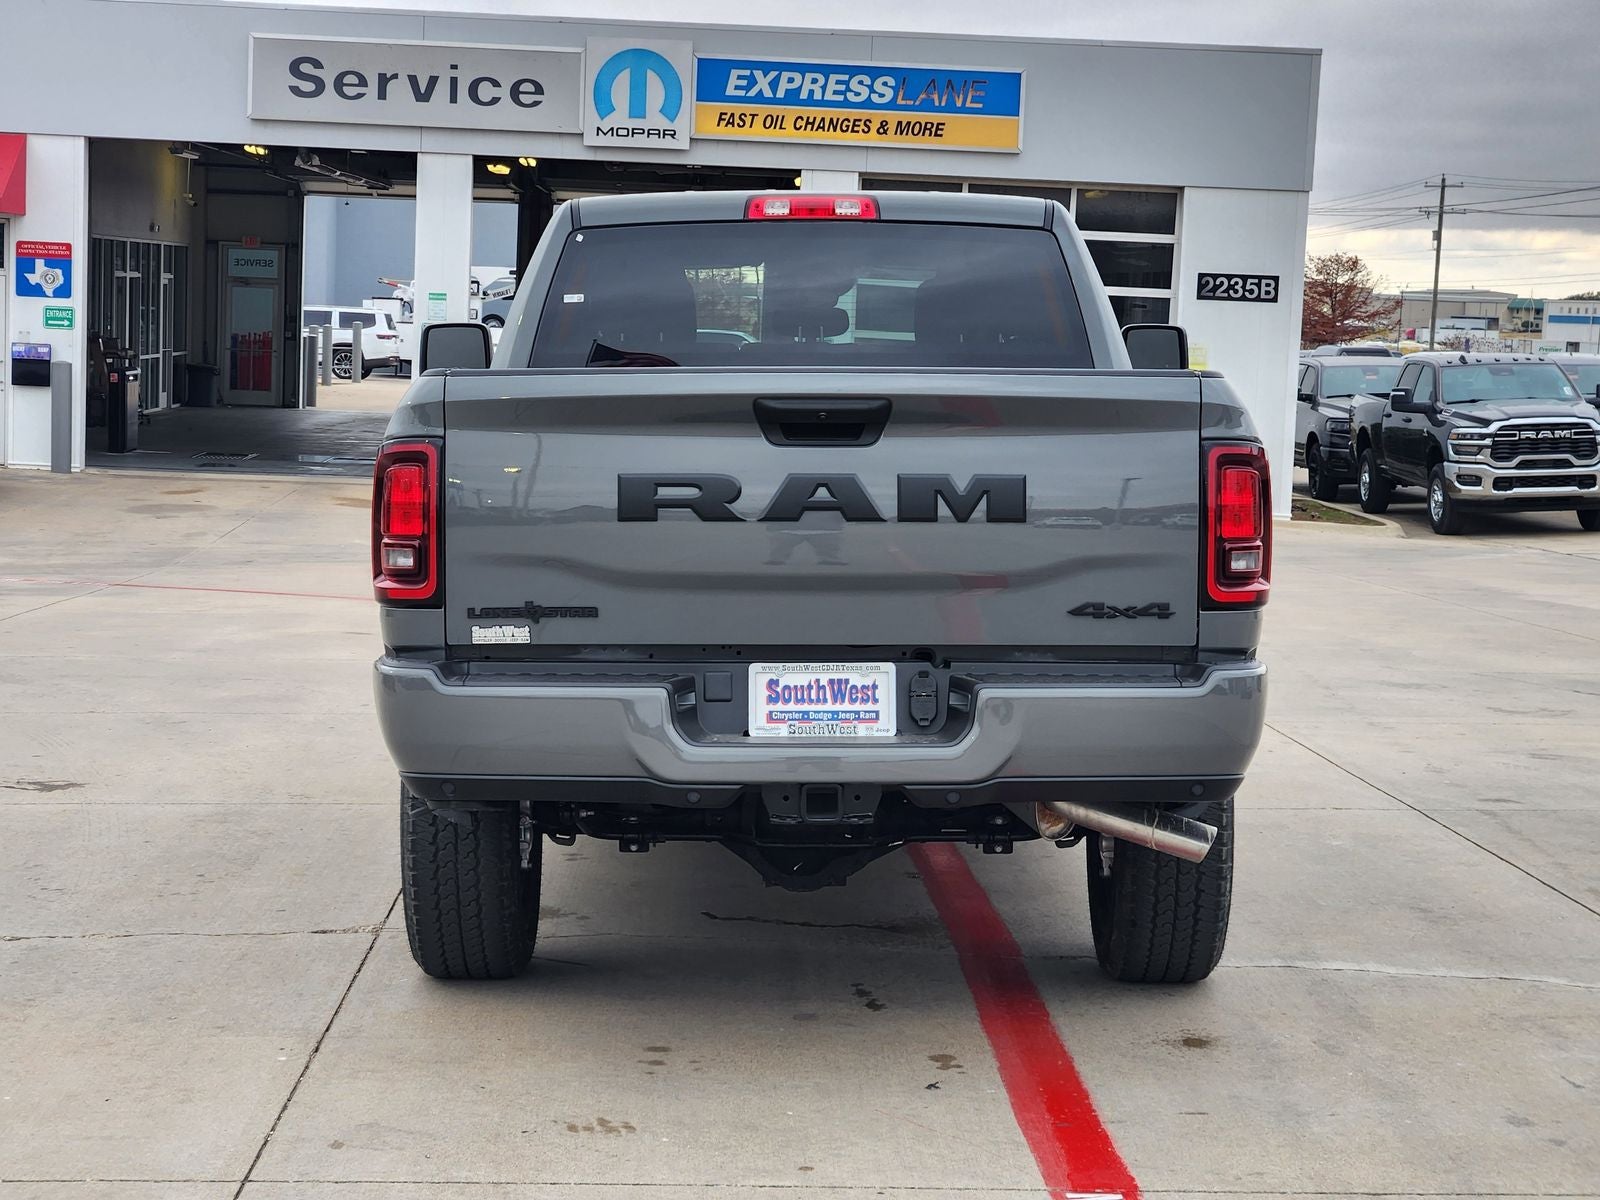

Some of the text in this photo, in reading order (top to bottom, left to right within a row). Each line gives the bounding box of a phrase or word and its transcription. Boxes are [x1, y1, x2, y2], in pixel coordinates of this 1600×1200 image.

[288, 56, 545, 108] Service
[716, 111, 946, 138] FAST OIL CHANGES & MORE
[595, 126, 678, 140] MOPAR
[1200, 276, 1277, 300] 2235B
[46, 309, 73, 319] ENTRANCE
[1520, 430, 1571, 439] RAM
[617, 473, 1027, 523] RAM
[467, 606, 599, 619] LONE STAR
[1066, 602, 1177, 619] 4x4
[766, 678, 880, 706] SouthWest
[772, 711, 876, 721] Chrysler Dodge Jeep Ram
[788, 723, 858, 735] SouthWest
